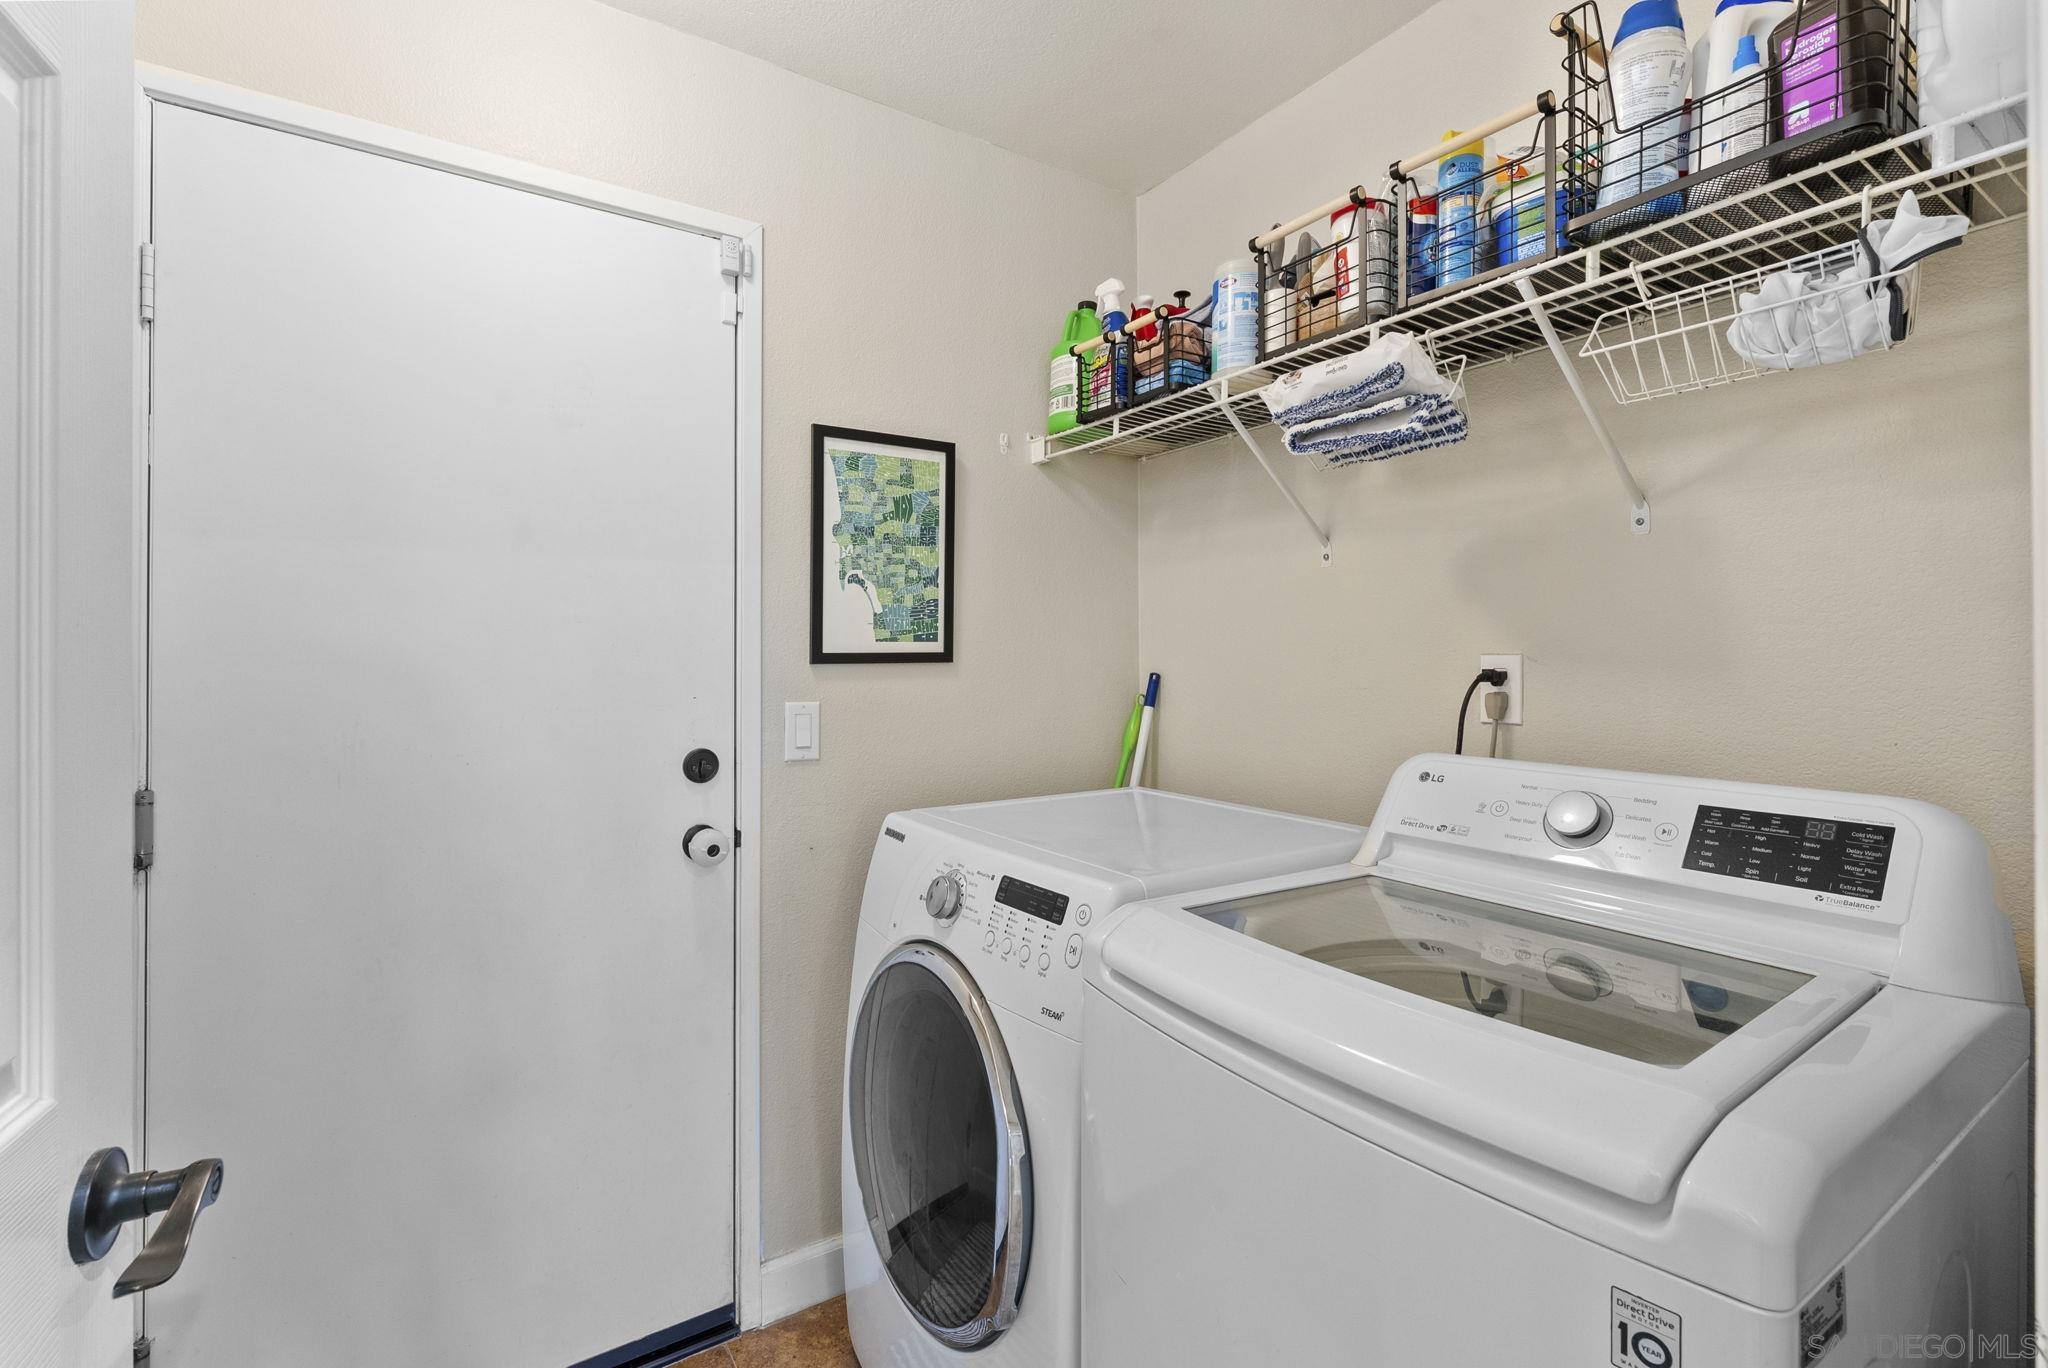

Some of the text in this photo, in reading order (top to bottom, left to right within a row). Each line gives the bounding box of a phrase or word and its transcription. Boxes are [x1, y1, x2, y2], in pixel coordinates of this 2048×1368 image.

[1790, 36, 1831, 60] eroxide
[1430, 774, 1445, 783] LG
[1400, 819, 1418, 828] Direct
[1418, 821, 1435, 831] Drive
[1851, 831, 1885, 841] Cold Wash
[1751, 846, 1773, 854] Medium
[1802, 841, 1821, 849] Heavy
[1800, 853, 1821, 861] Normal
[1846, 847, 1883, 858] Delay Wash
[1745, 867, 1760, 876] Spin
[1797, 865, 1812, 873] Light
[1843, 864, 1878, 875] Water Plus
[1794, 875, 1808, 883] Soil
[1839, 883, 1874, 895] Extra Rinse
[1040, 1006, 1062, 1022] STEAM
[1616, 1297, 1675, 1330] Direct Drive
[1641, 1344, 1662, 1360] YEAR
